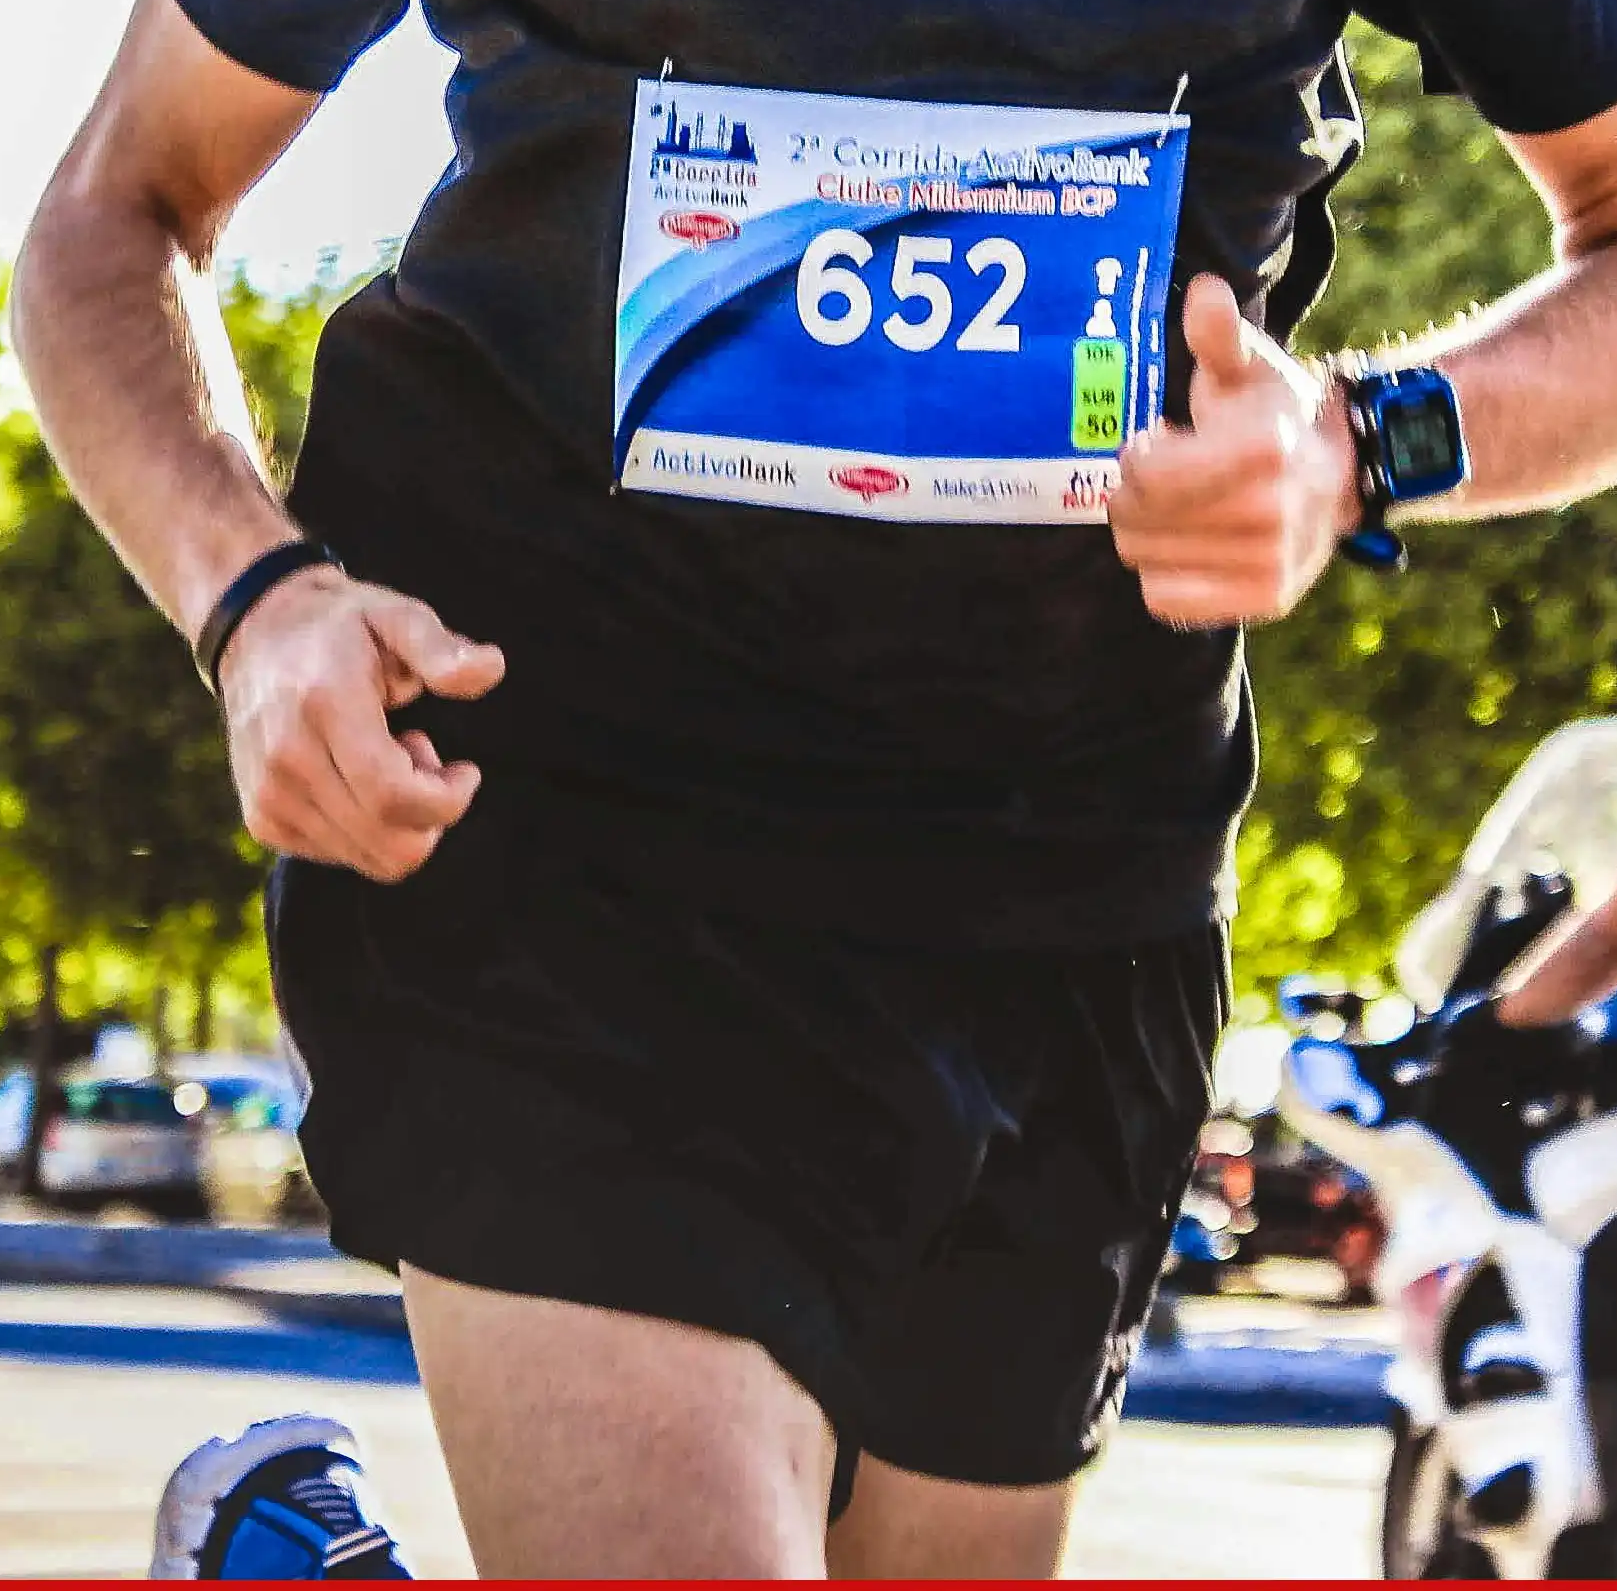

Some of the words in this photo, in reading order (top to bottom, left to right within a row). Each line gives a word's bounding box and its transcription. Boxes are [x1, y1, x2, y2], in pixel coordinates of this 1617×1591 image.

[833, 135, 961, 176] Corrida
[972, 144, 1152, 186] ActivoBank
[816, 172, 902, 208] Clube
[907, 176, 1057, 215] Millennium
[1060, 184, 1118, 217] BCP
[796, 228, 1028, 353] 652
[1086, 412, 1119, 440] 50
[652, 445, 797, 487] ActivoBank
